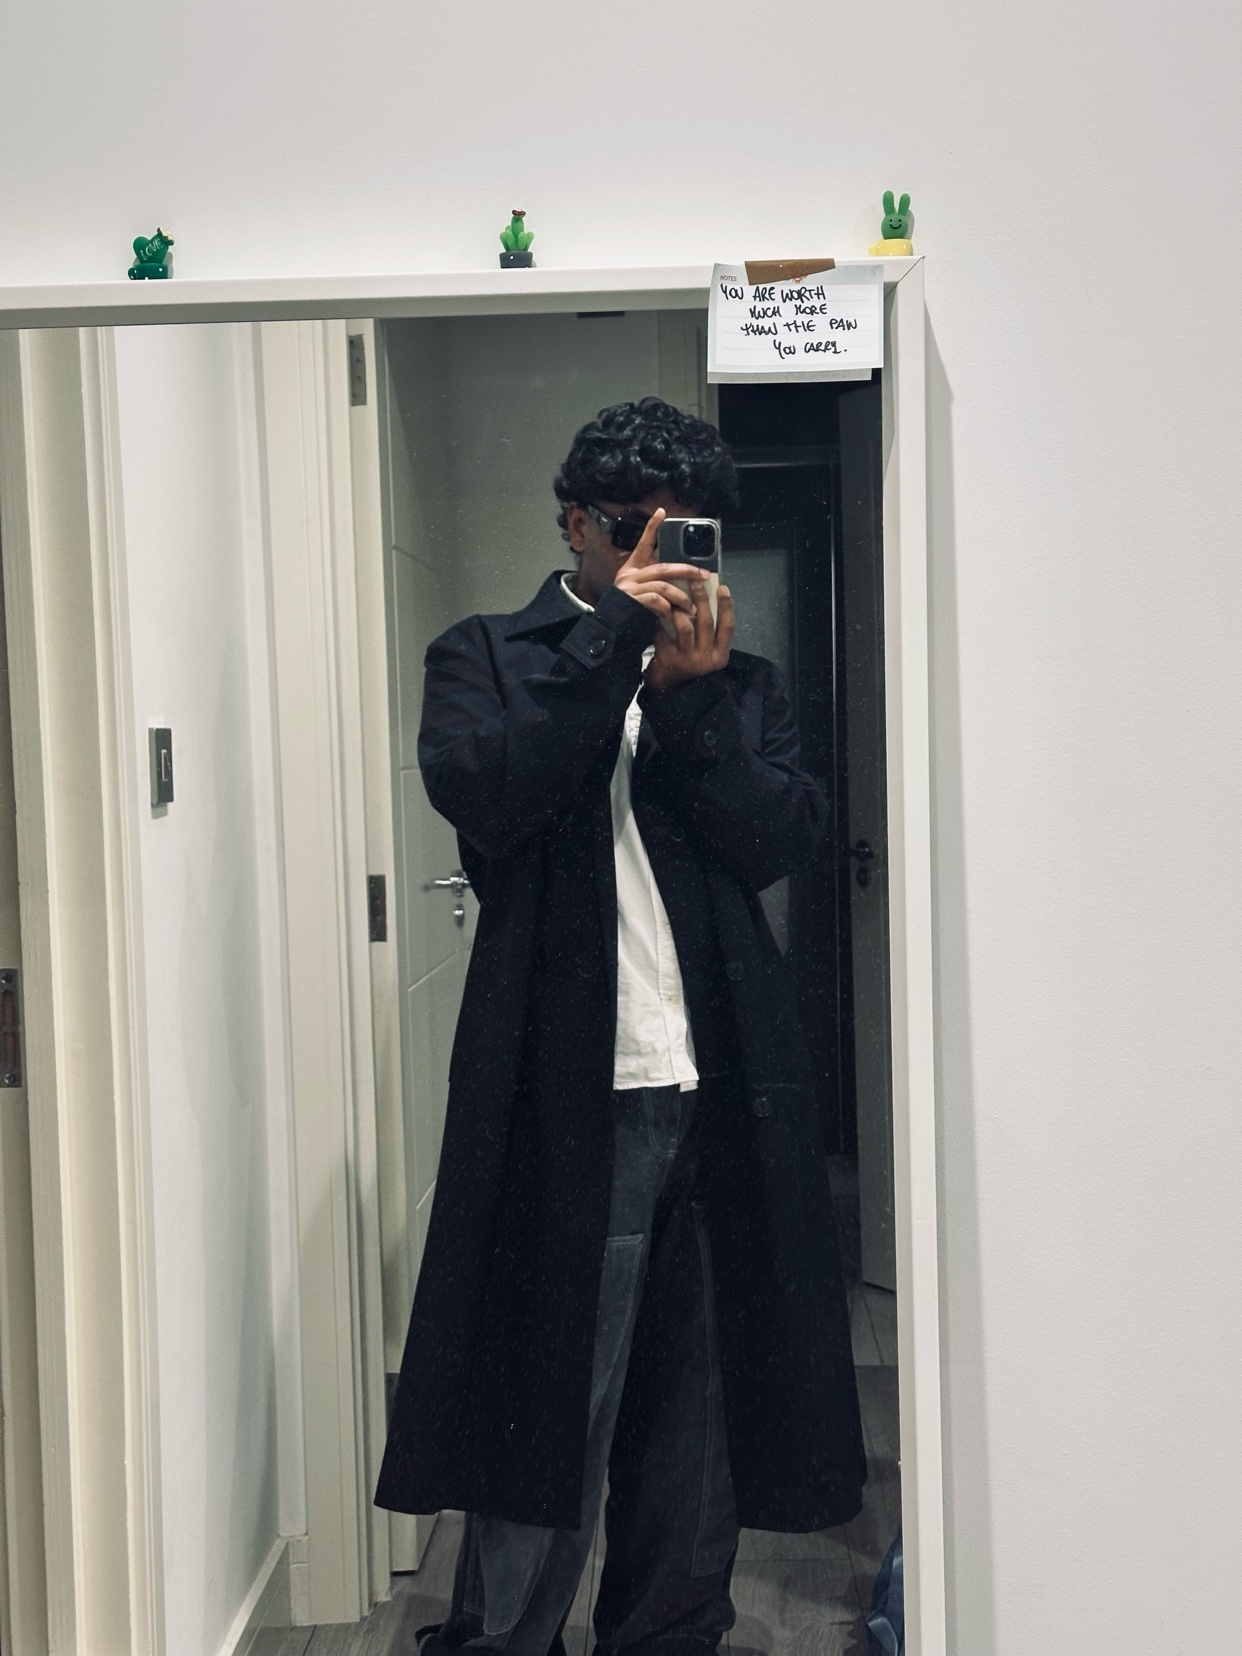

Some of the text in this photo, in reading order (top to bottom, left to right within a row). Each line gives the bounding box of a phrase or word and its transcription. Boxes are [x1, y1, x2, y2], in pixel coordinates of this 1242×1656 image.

[140, 238, 163, 260] LOVE
[720, 283, 826, 303] YOU ARE WORTH
[749, 303, 827, 320] MUCH MORE
[740, 322, 778, 337] THAN
[783, 320, 816, 333] THE
[773, 339, 847, 360] YOU CARRY.
